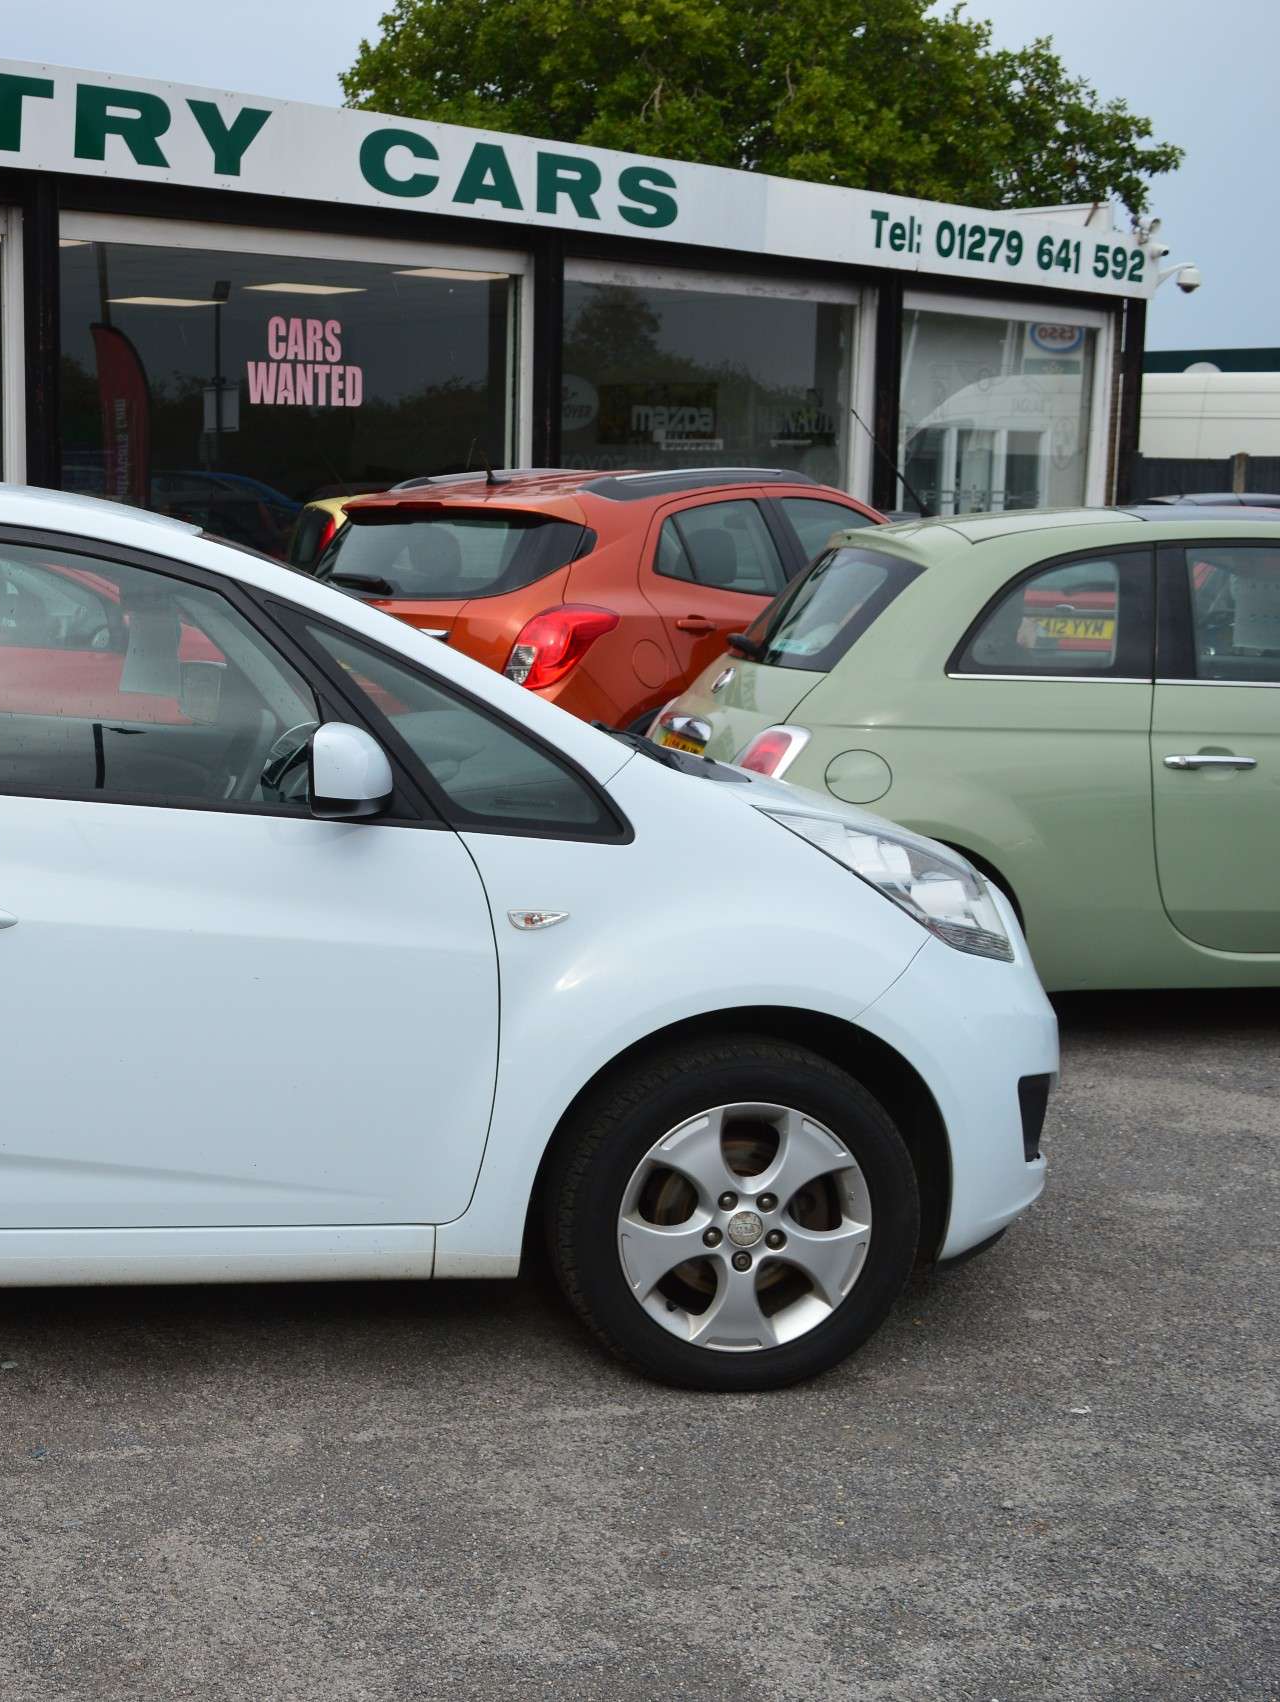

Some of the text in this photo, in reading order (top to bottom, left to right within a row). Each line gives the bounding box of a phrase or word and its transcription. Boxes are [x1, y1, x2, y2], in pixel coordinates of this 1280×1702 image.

[359, 128, 679, 229] CARS
[871, 210, 1145, 282] Tel: 01279 641 592
[267, 315, 342, 362] CARS
[246, 361, 363, 407] WANTED
